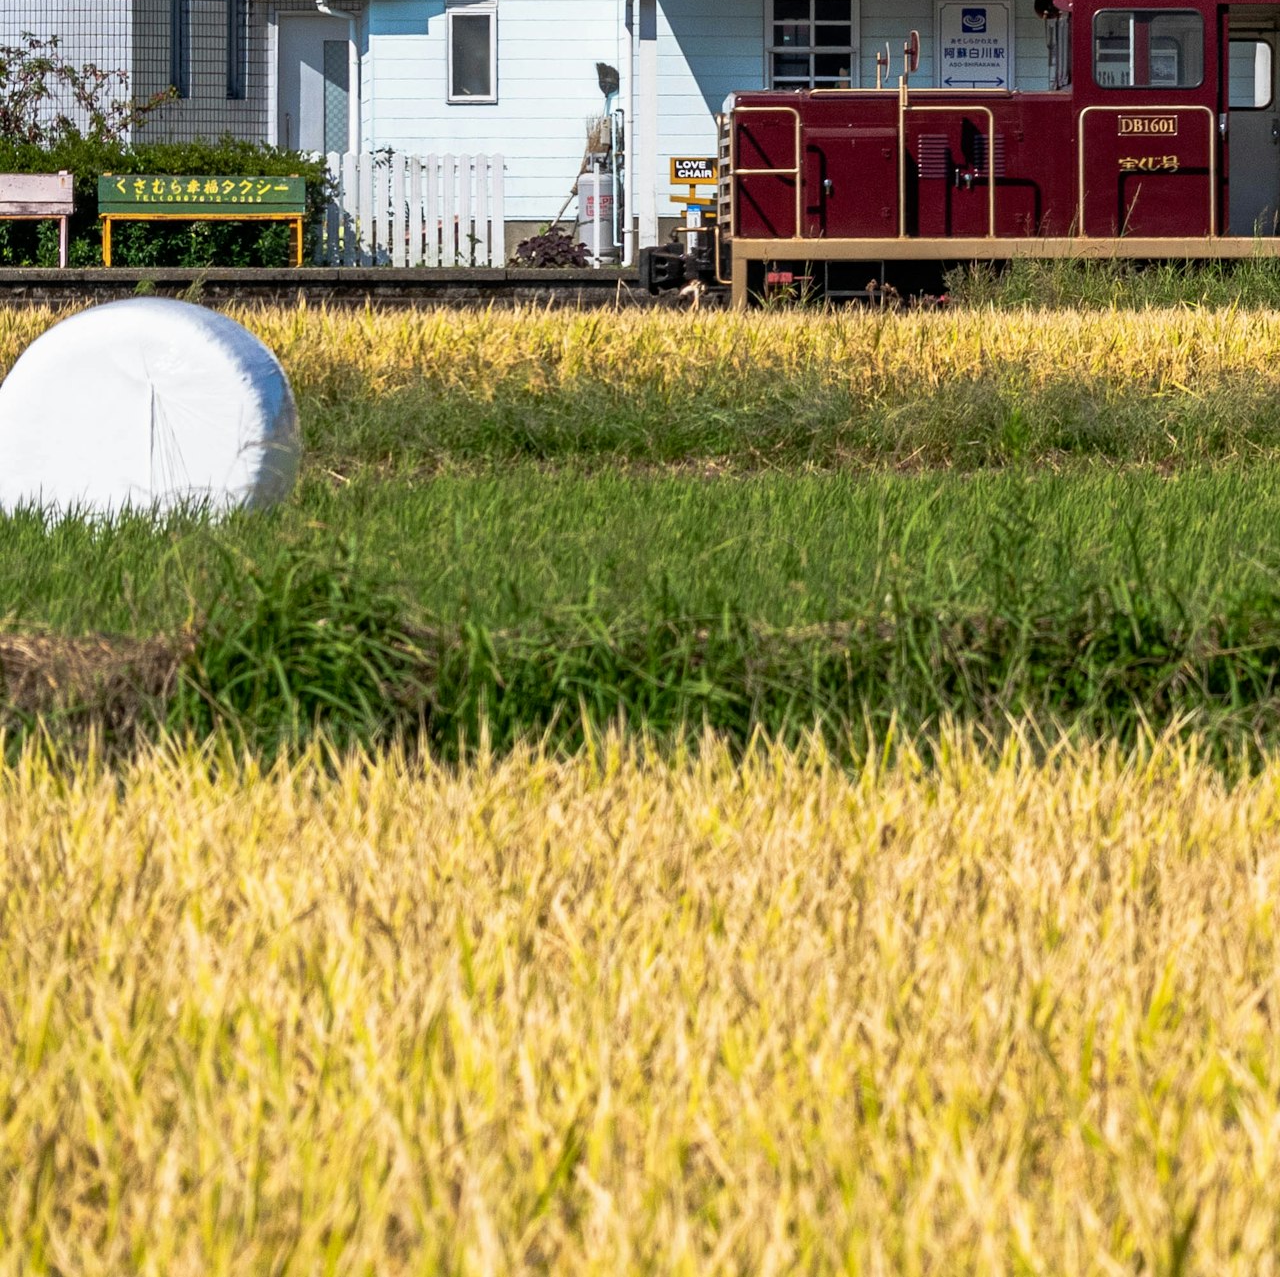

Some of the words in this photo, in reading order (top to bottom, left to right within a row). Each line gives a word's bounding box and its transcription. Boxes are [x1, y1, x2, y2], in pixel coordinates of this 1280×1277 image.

[943, 47, 1005, 59] 阿蘇白川駅
[1120, 118, 1175, 133] DB1601
[675, 160, 706, 169] LOVE
[1118, 155, 1180, 172] 宝くじ号
[678, 170, 712, 178] CHAIR
[116, 178, 289, 195] くさむら幸福タクシー
